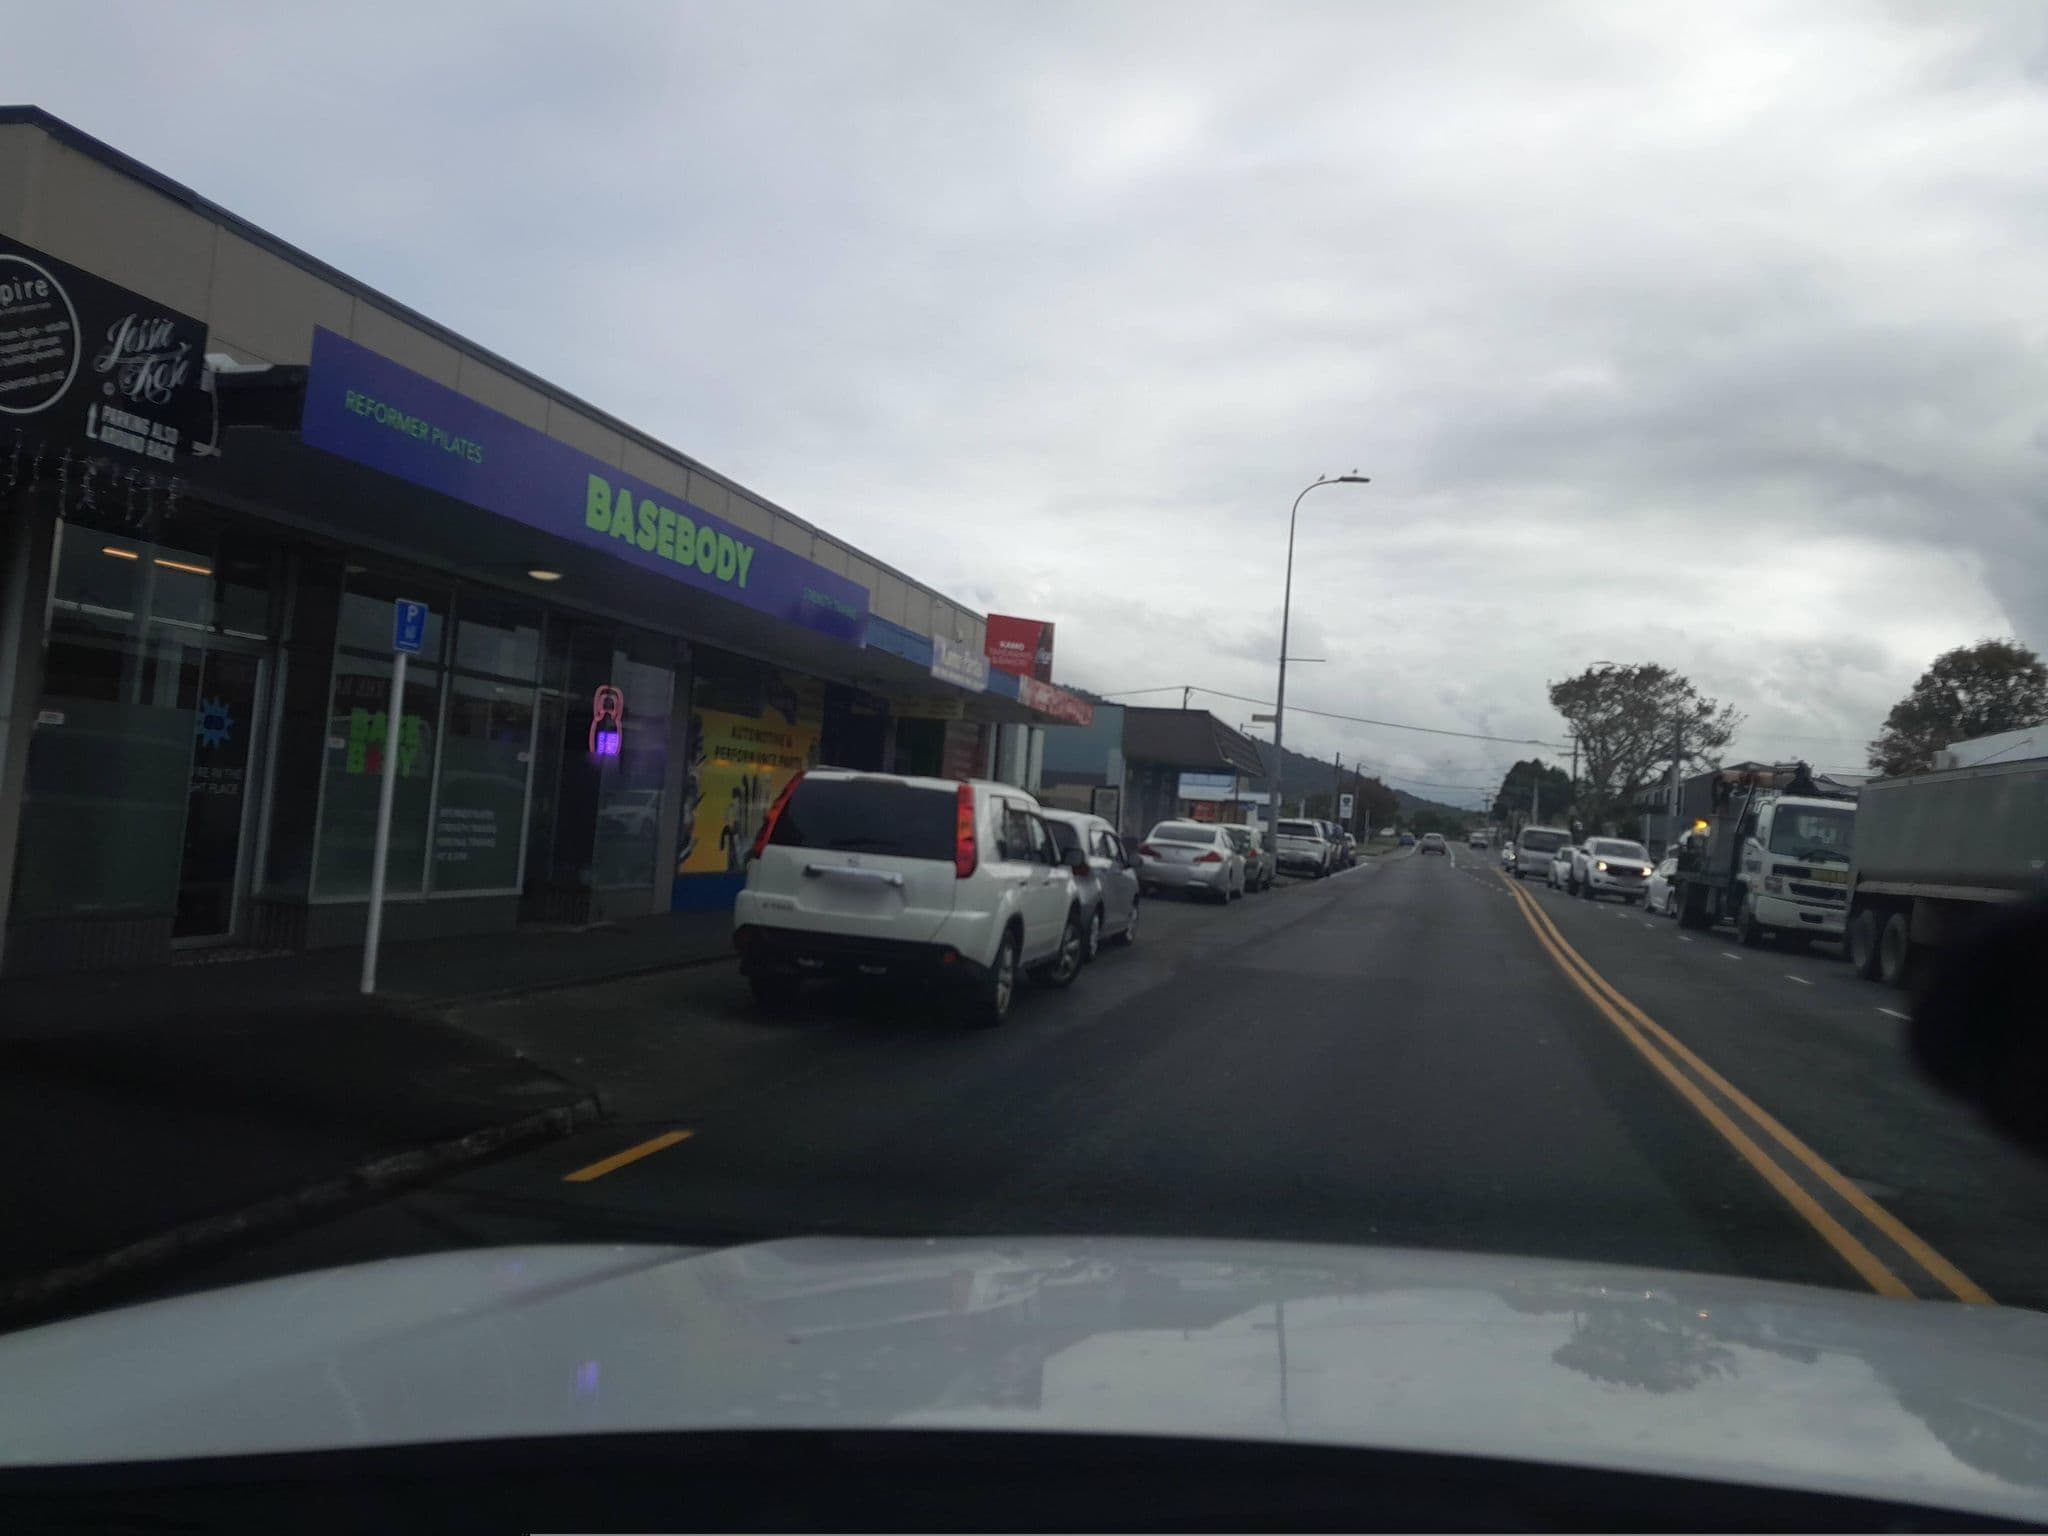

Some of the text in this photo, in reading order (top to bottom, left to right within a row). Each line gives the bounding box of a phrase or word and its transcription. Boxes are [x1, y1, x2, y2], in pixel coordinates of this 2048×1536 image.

[345, 389, 482, 464] REFORMER PILATES
[585, 472, 754, 589] BASEBODY
[406, 604, 418, 623] P
